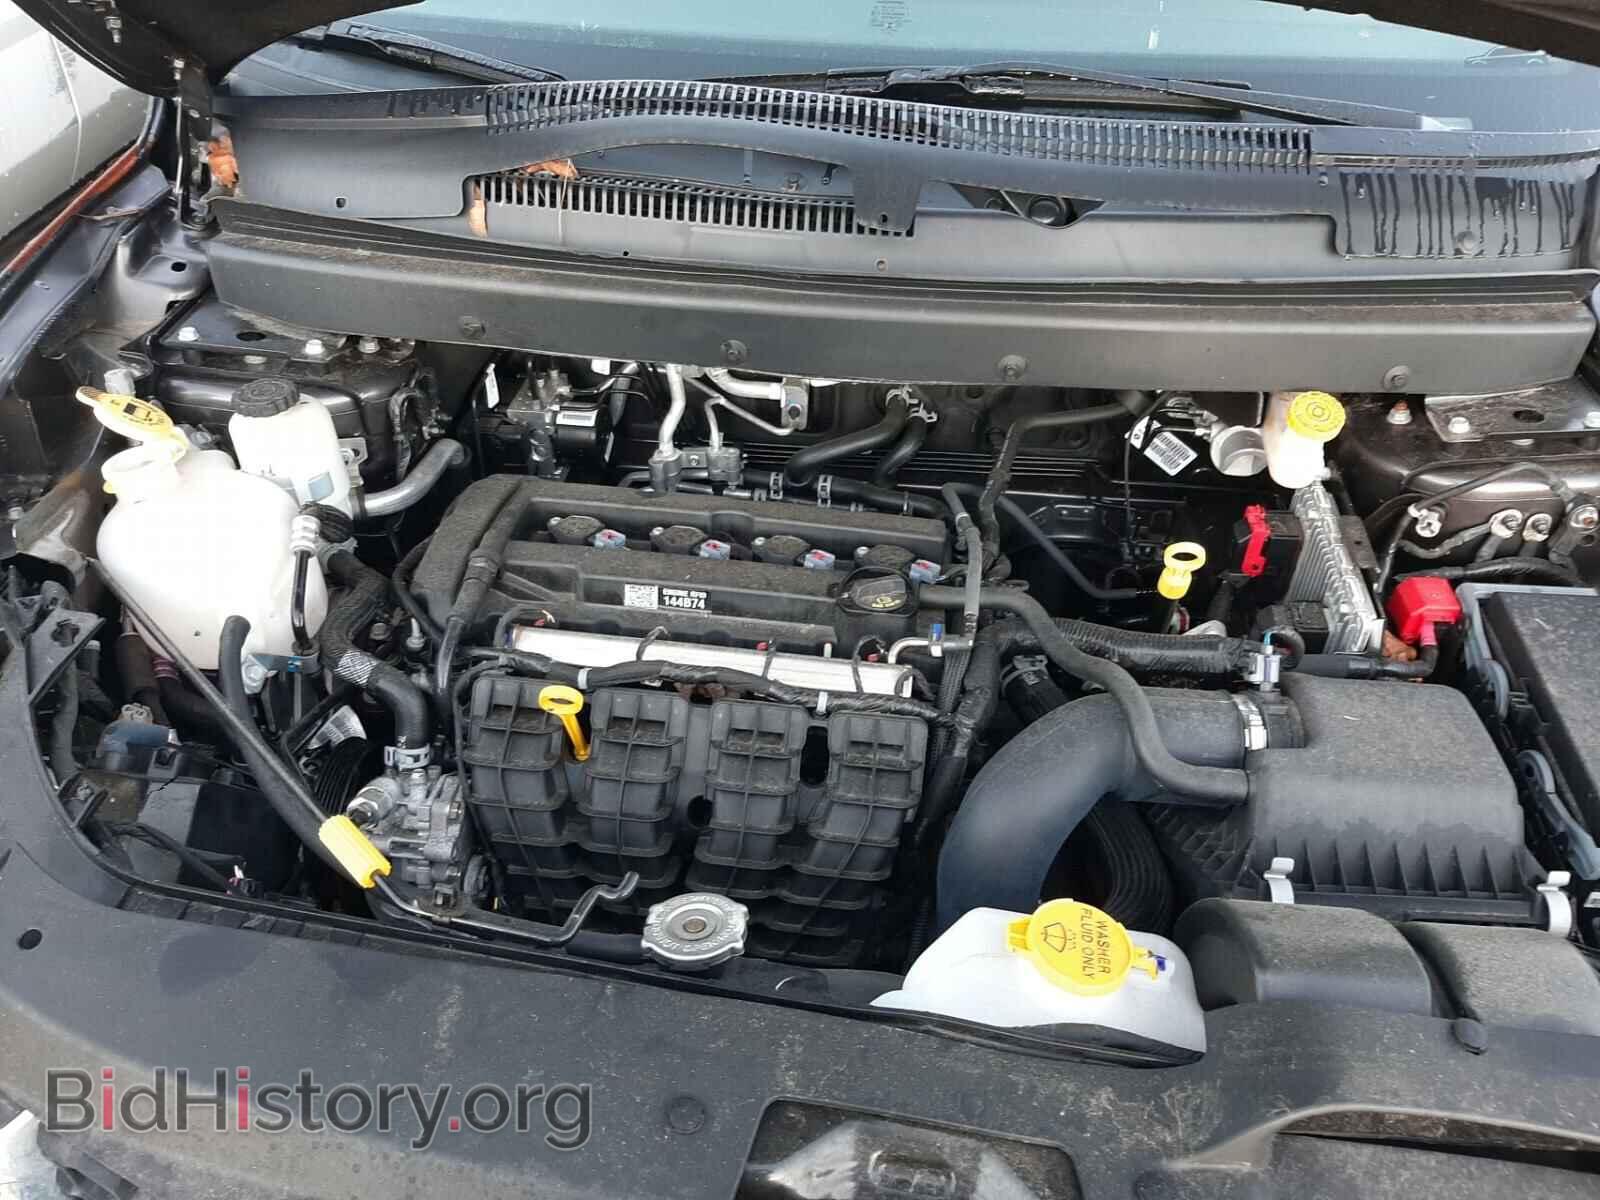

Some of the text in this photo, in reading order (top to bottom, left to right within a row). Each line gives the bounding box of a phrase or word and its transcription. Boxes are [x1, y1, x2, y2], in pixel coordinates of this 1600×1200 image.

[1080, 907, 1095, 980] FLUID ONLY
[1096, 920, 1111, 974] WASHER
